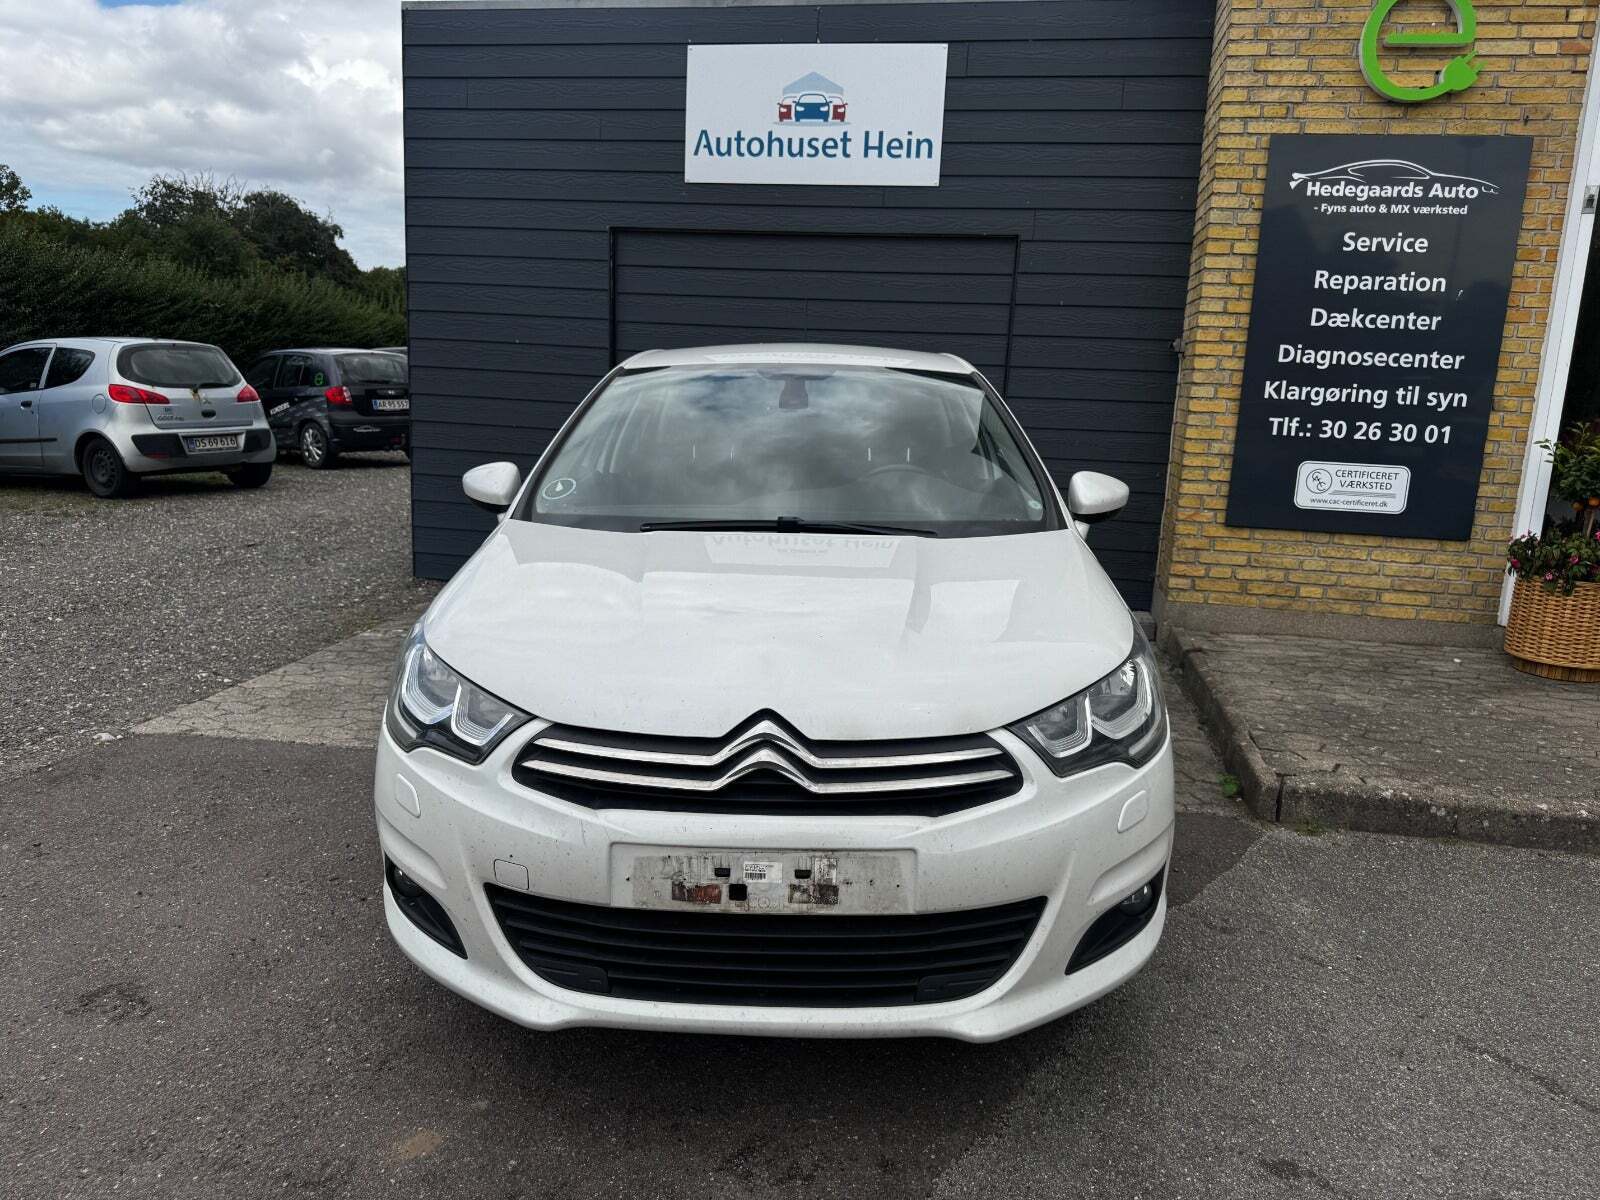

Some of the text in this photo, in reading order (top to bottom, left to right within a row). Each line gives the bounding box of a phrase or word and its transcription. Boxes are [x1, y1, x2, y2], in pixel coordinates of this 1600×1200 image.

[693, 129, 934, 160] Autohuset Hein
[1306, 181, 1479, 201] Hedegaards Auto
[1320, 203, 1347, 215] Fyns
[1349, 205, 1377, 214] auto
[1379, 204, 1387, 214] &
[1390, 205, 1410, 214] MX
[1413, 205, 1468, 215] værksted
[1342, 231, 1429, 253] Service
[1313, 269, 1447, 295] Reparation
[1310, 307, 1442, 331] Dækcenter
[1277, 344, 1466, 370] Diagnosecenter
[1263, 380, 1468, 412] Klargøring til syn
[1268, 417, 1451, 444] Tlf.: 30 26 30 01
[194, 437, 236, 449] DS 69 616
[1335, 469, 1400, 480] CERTIFICERET
[1339, 480, 1393, 490] VÆRKSTED
[1310, 497, 1388, 508] www.cac-certificeret.dk
